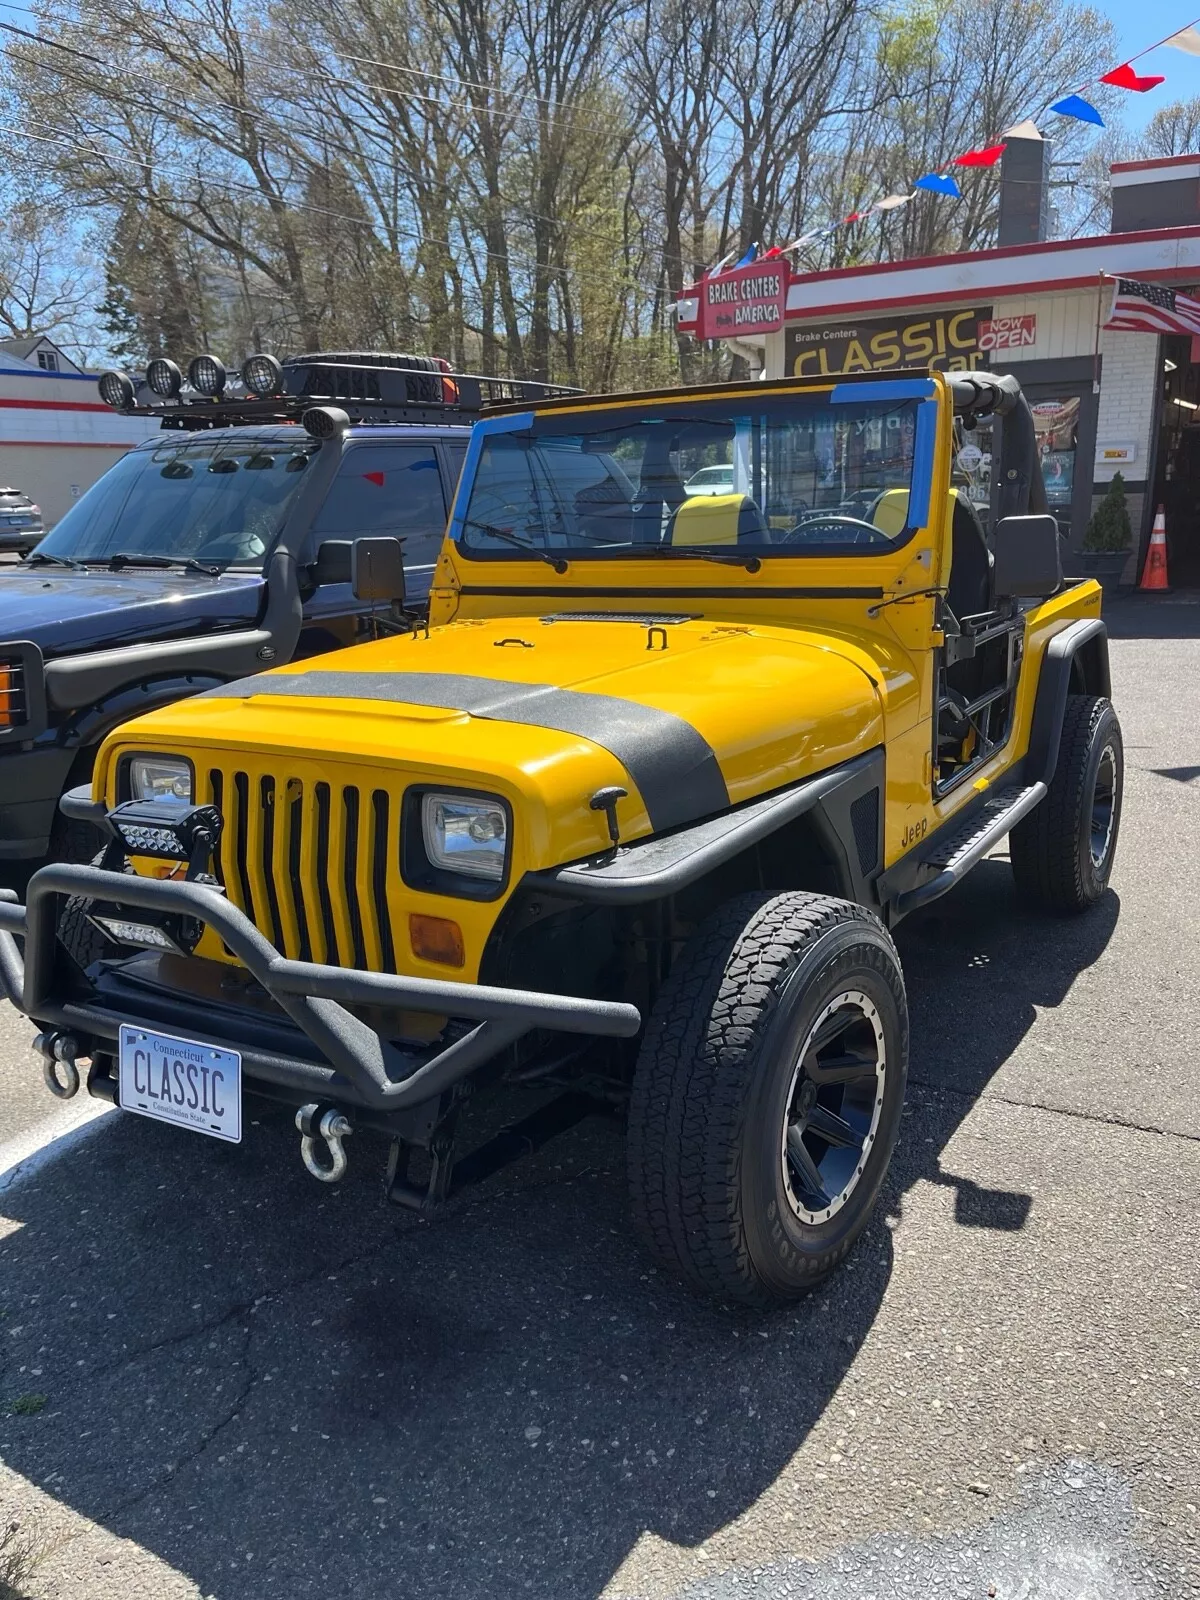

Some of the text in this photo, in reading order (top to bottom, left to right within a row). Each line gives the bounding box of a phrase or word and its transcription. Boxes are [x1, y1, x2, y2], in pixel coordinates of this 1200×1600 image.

[708, 275, 780, 304] BRAKE CENTERS
[734, 304, 780, 326] AMERICA
[990, 317, 1023, 332] NOW
[793, 311, 977, 377] CLASSIC
[795, 329, 858, 343] Brake Centers
[978, 327, 1037, 350] OPEN
[901, 817, 928, 848] Jeep
[153, 1040, 204, 1064] Connecticut
[134, 1049, 225, 1118] CLASSIC
[152, 1101, 206, 1125] Constitution State
